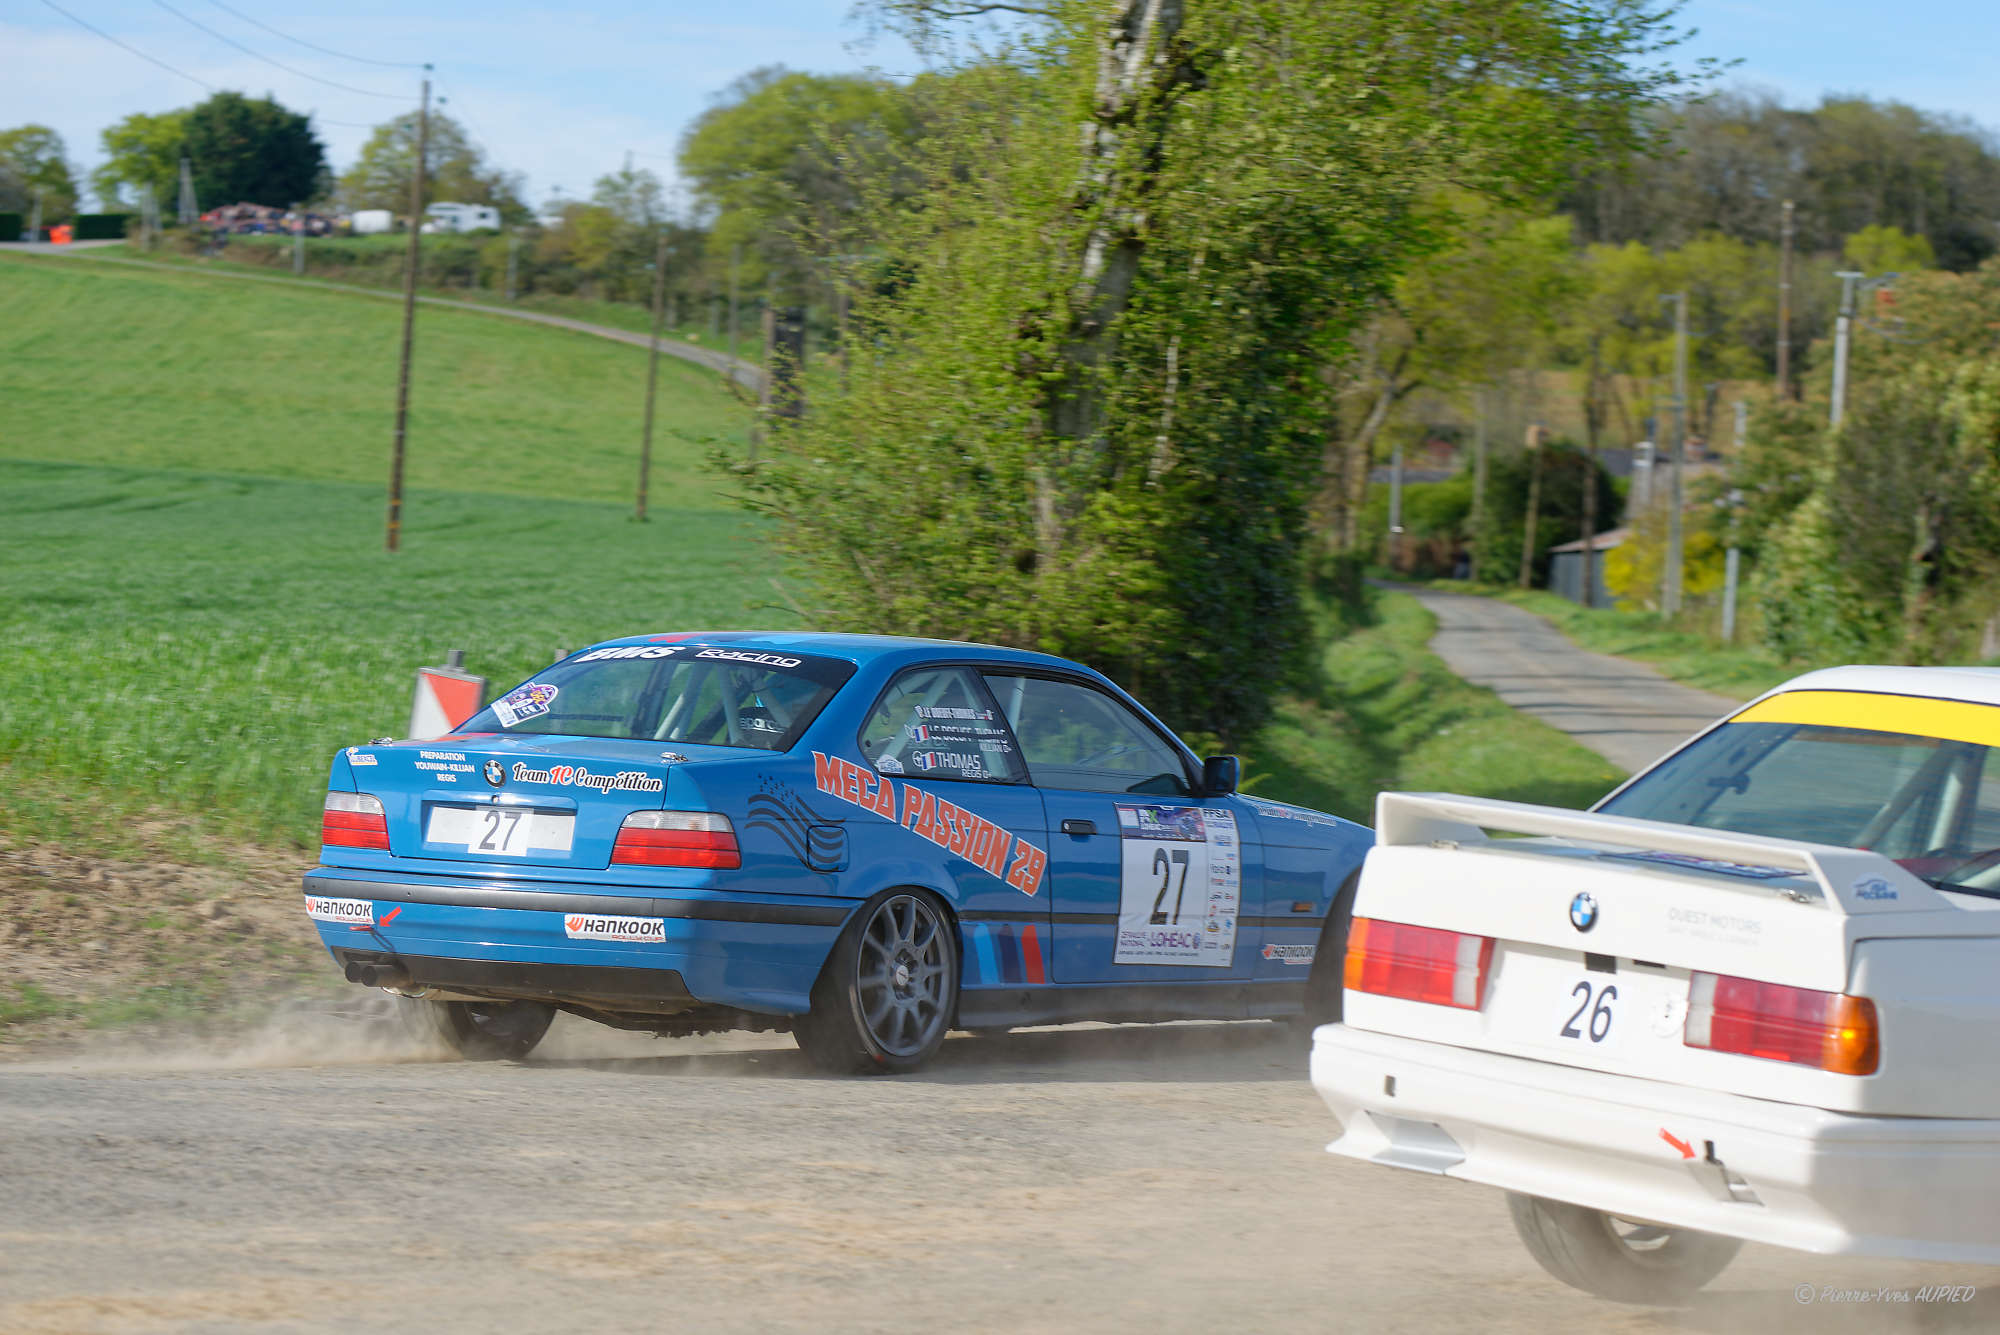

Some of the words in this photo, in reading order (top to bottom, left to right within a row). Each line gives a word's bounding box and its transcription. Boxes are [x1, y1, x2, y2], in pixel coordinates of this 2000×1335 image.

[695, 648, 802, 668] Racing
[513, 763, 548, 782] Team
[575, 770, 662, 793] Compétition
[936, 752, 981, 769] THOMAS
[478, 810, 523, 851] 27
[811, 751, 897, 823] MECA
[900, 782, 1013, 879] PASSION
[1005, 837, 1047, 897] 29
[1150, 848, 1189, 925] 27
[1560, 980, 1618, 1043] 26
